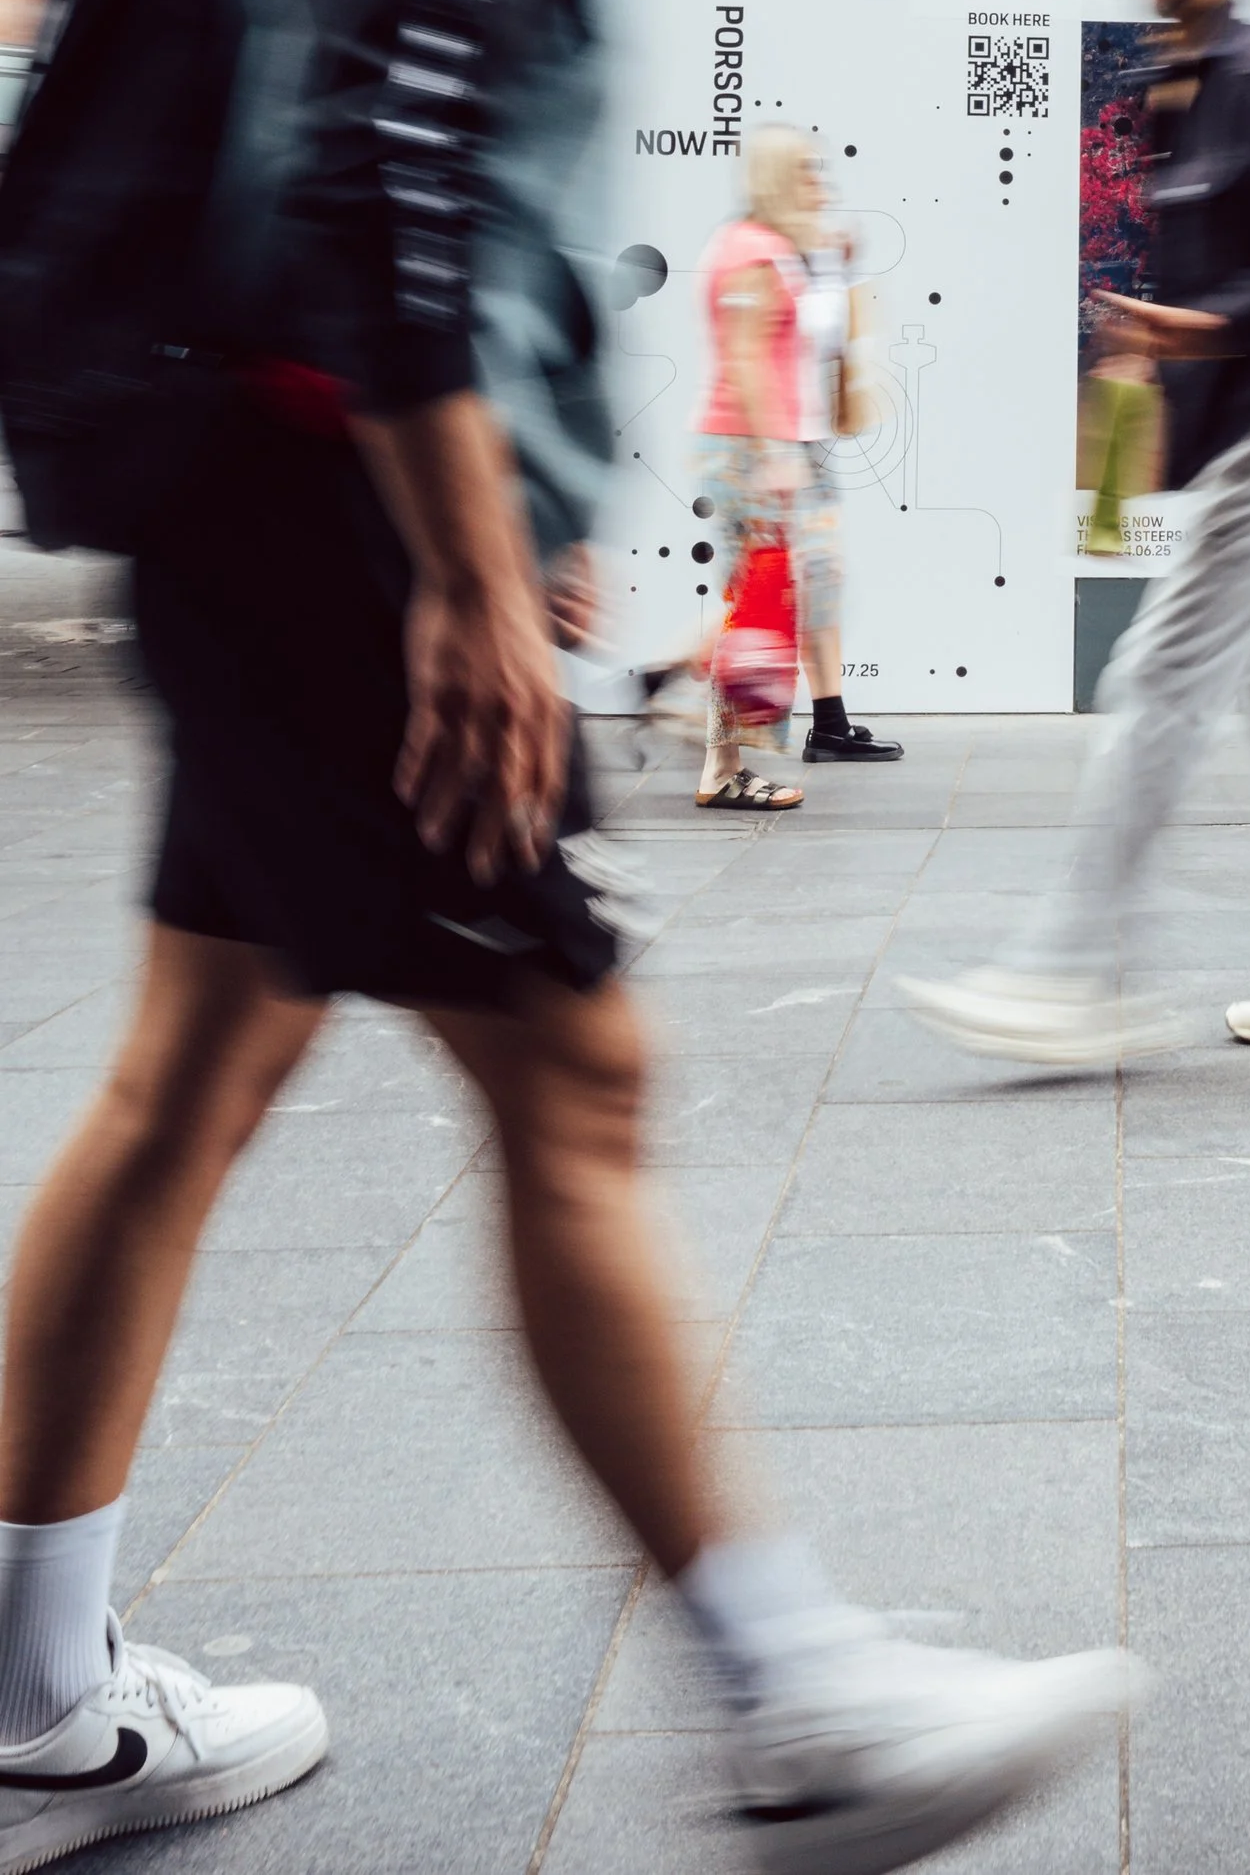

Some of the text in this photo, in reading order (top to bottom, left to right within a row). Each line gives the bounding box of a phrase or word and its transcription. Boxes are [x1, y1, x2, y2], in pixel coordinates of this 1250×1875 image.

[969, 13, 1050, 26] BOOK HERE
[713, 6, 743, 156] PORSCHE
[636, 130, 707, 155] NOW
[1133, 517, 1163, 527] NOW
[1134, 531, 1182, 541] STEERS
